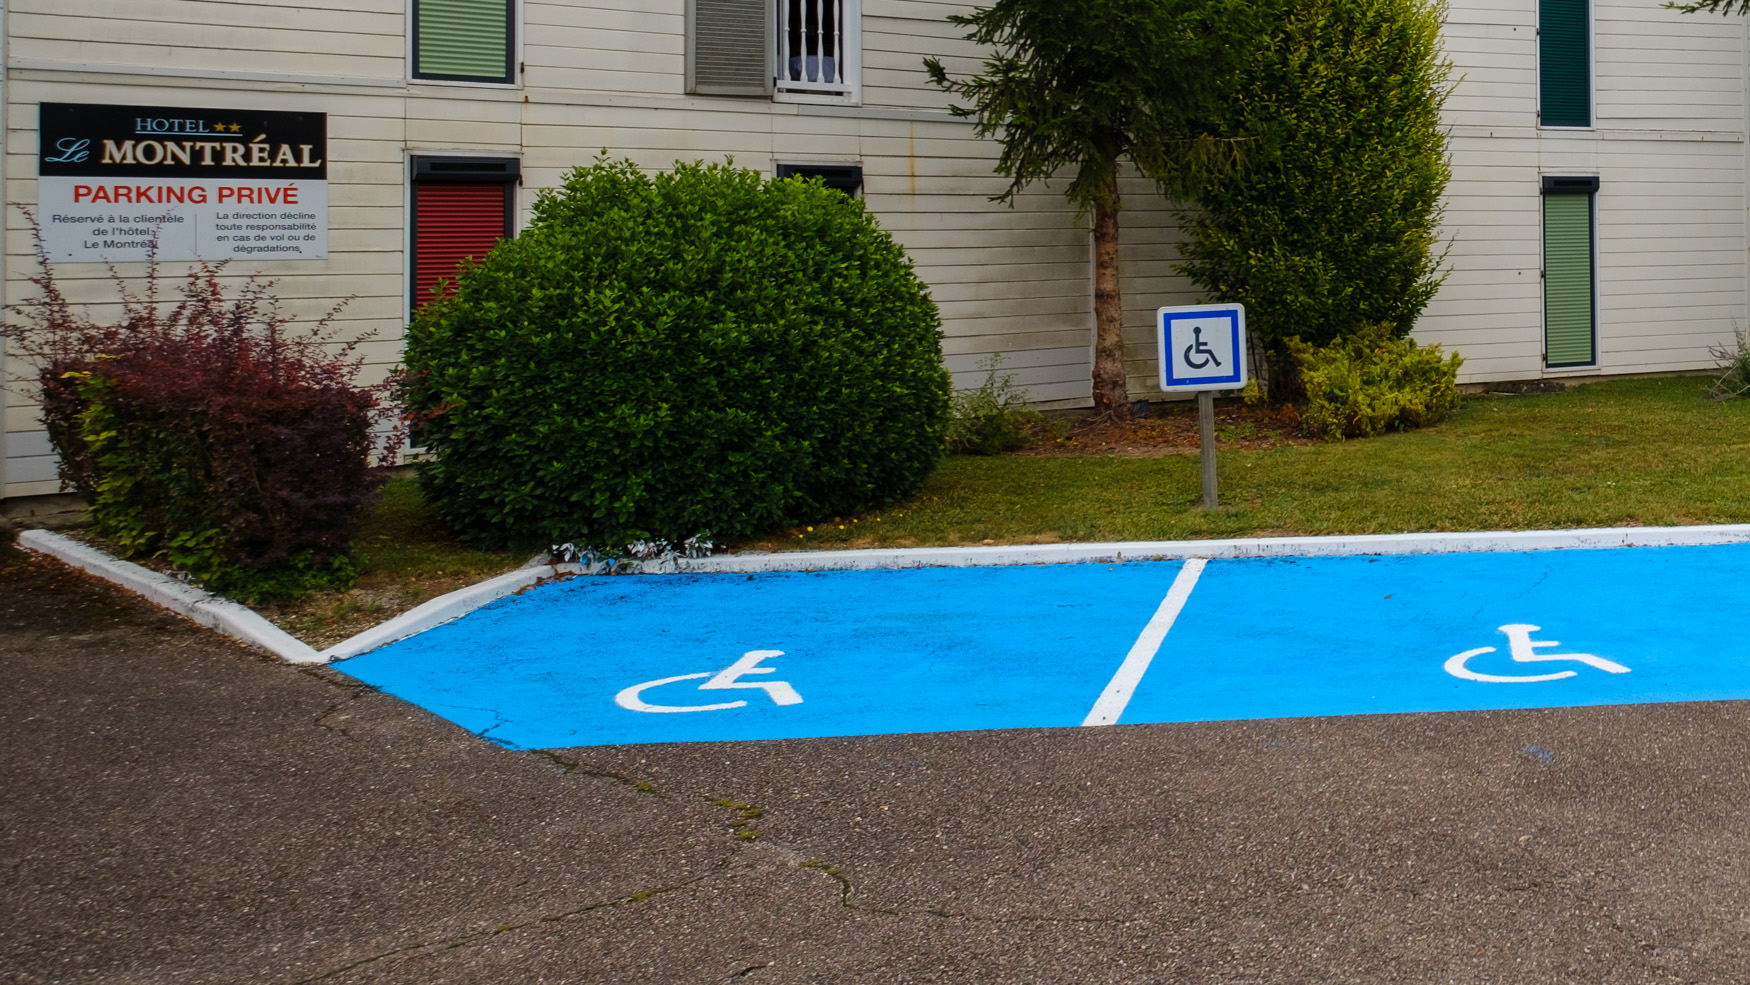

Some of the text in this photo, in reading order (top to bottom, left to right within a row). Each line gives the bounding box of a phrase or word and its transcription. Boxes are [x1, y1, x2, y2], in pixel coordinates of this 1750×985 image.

[135, 118, 209, 133] HOTEL
[44, 133, 321, 168] Le MONTRÉAL
[73, 183, 299, 205] PARKING PRIVÉ
[52, 214, 185, 223] Réservé à la clientèle
[216, 210, 317, 220] La direction décline
[92, 227, 108, 236] de
[215, 222, 317, 232] toute responsabilité
[254, 233, 267, 241] de
[269, 233, 285, 241] vol
[303, 232, 316, 241] de
[84, 240, 99, 249] Le
[233, 244, 301, 254] dégradations
